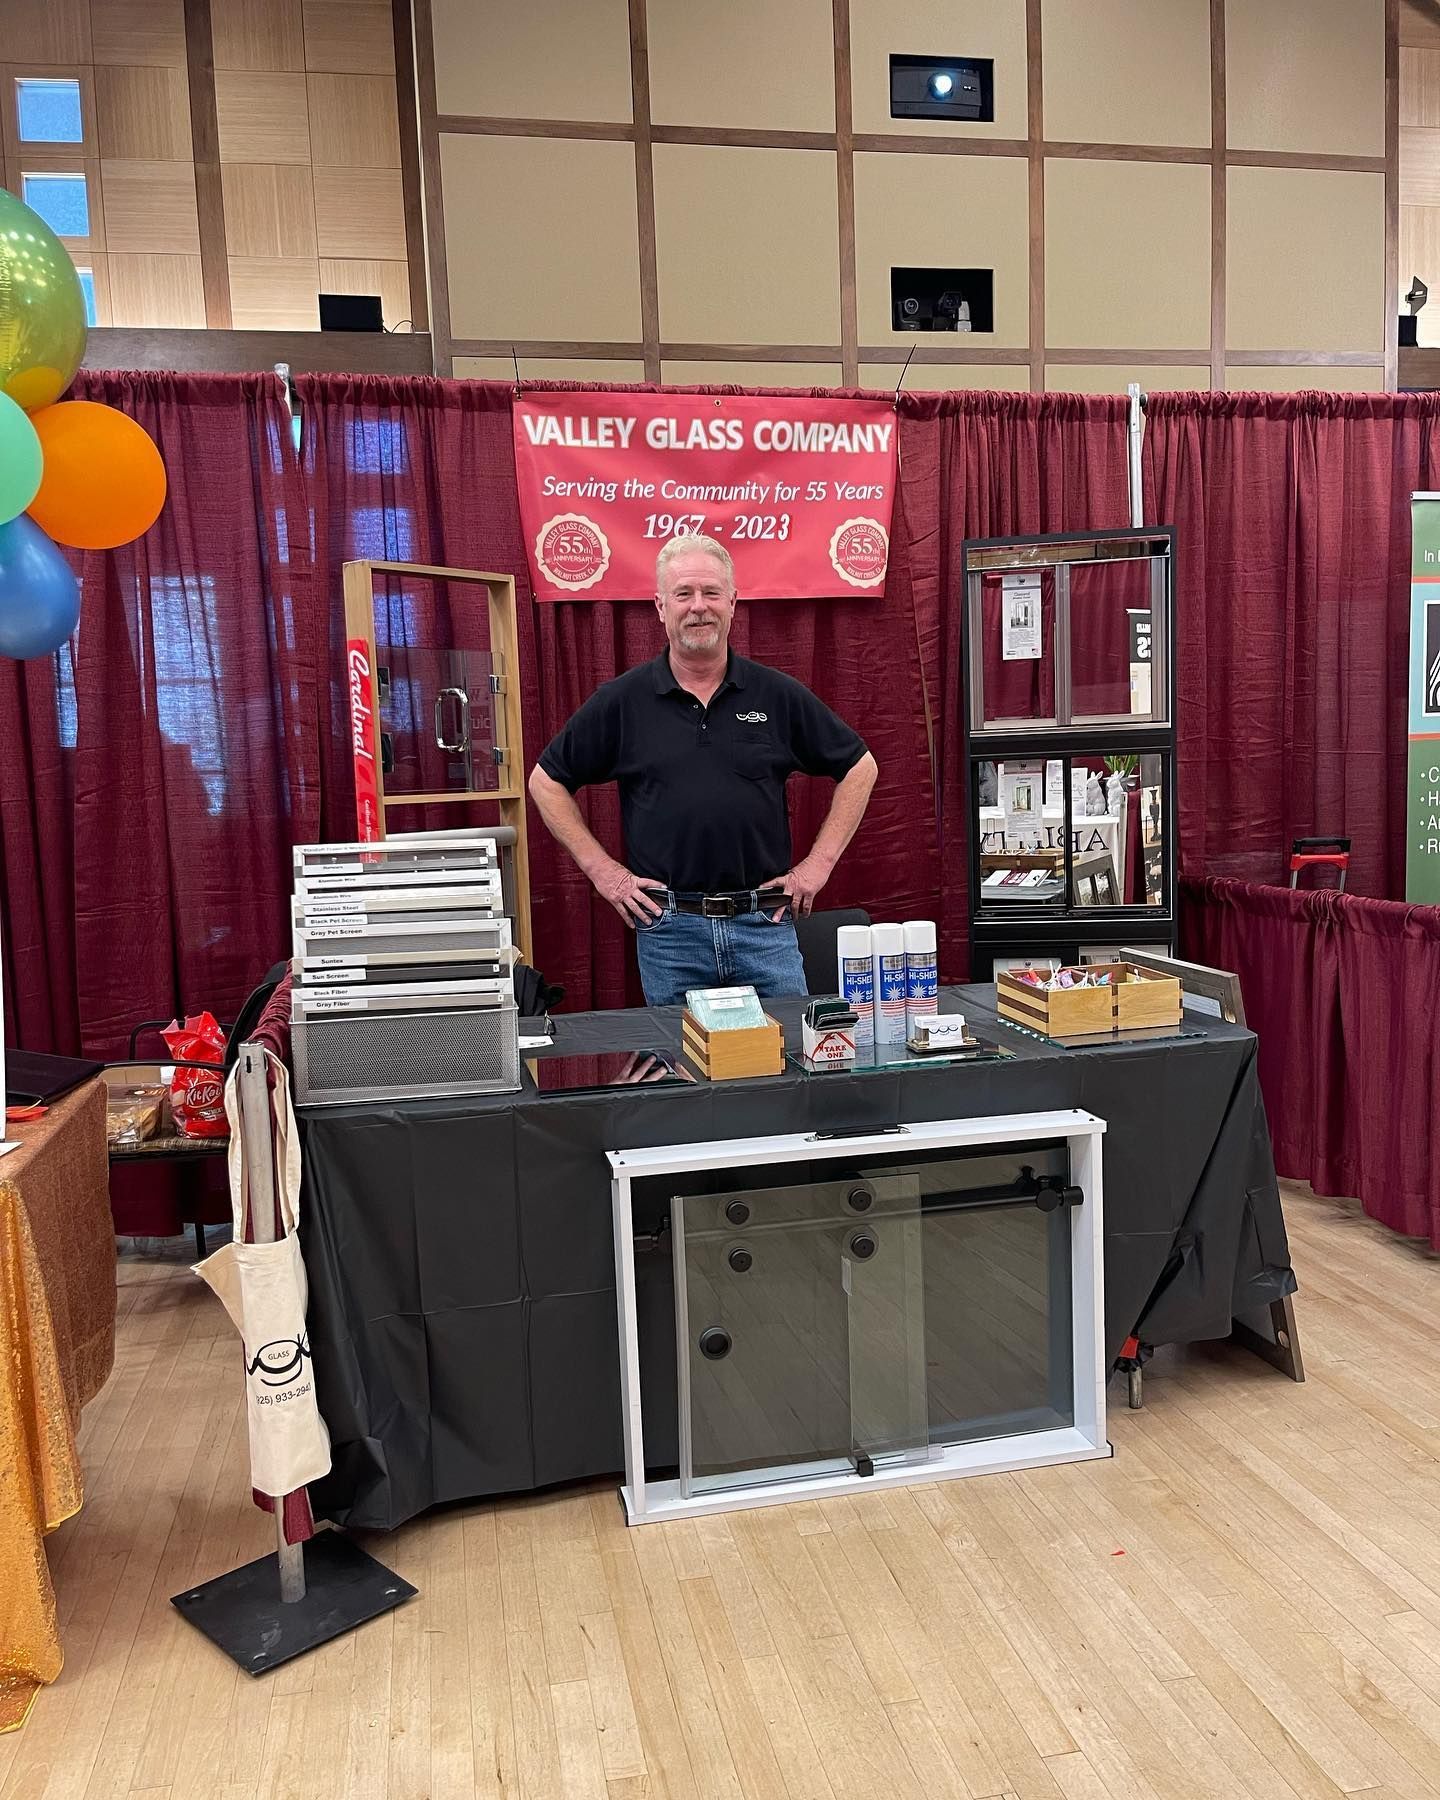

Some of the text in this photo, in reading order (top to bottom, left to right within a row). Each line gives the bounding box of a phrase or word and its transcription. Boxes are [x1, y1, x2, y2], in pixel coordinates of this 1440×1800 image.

[522, 414, 893, 453] VALLEY GLASS COMPANY
[542, 475, 884, 505] Serving the Community for 55 Years
[544, 522, 601, 549] VALLEY GLASS COMPANY
[642, 513, 706, 540] 1967
[731, 513, 790, 541] 2023
[1424, 549, 1435, 563] In
[349, 649, 373, 760] Cardinal
[824, 1044, 847, 1052] TAKE
[827, 1051, 844, 1059] ONE
[267, 1349, 290, 1361] GLASS
